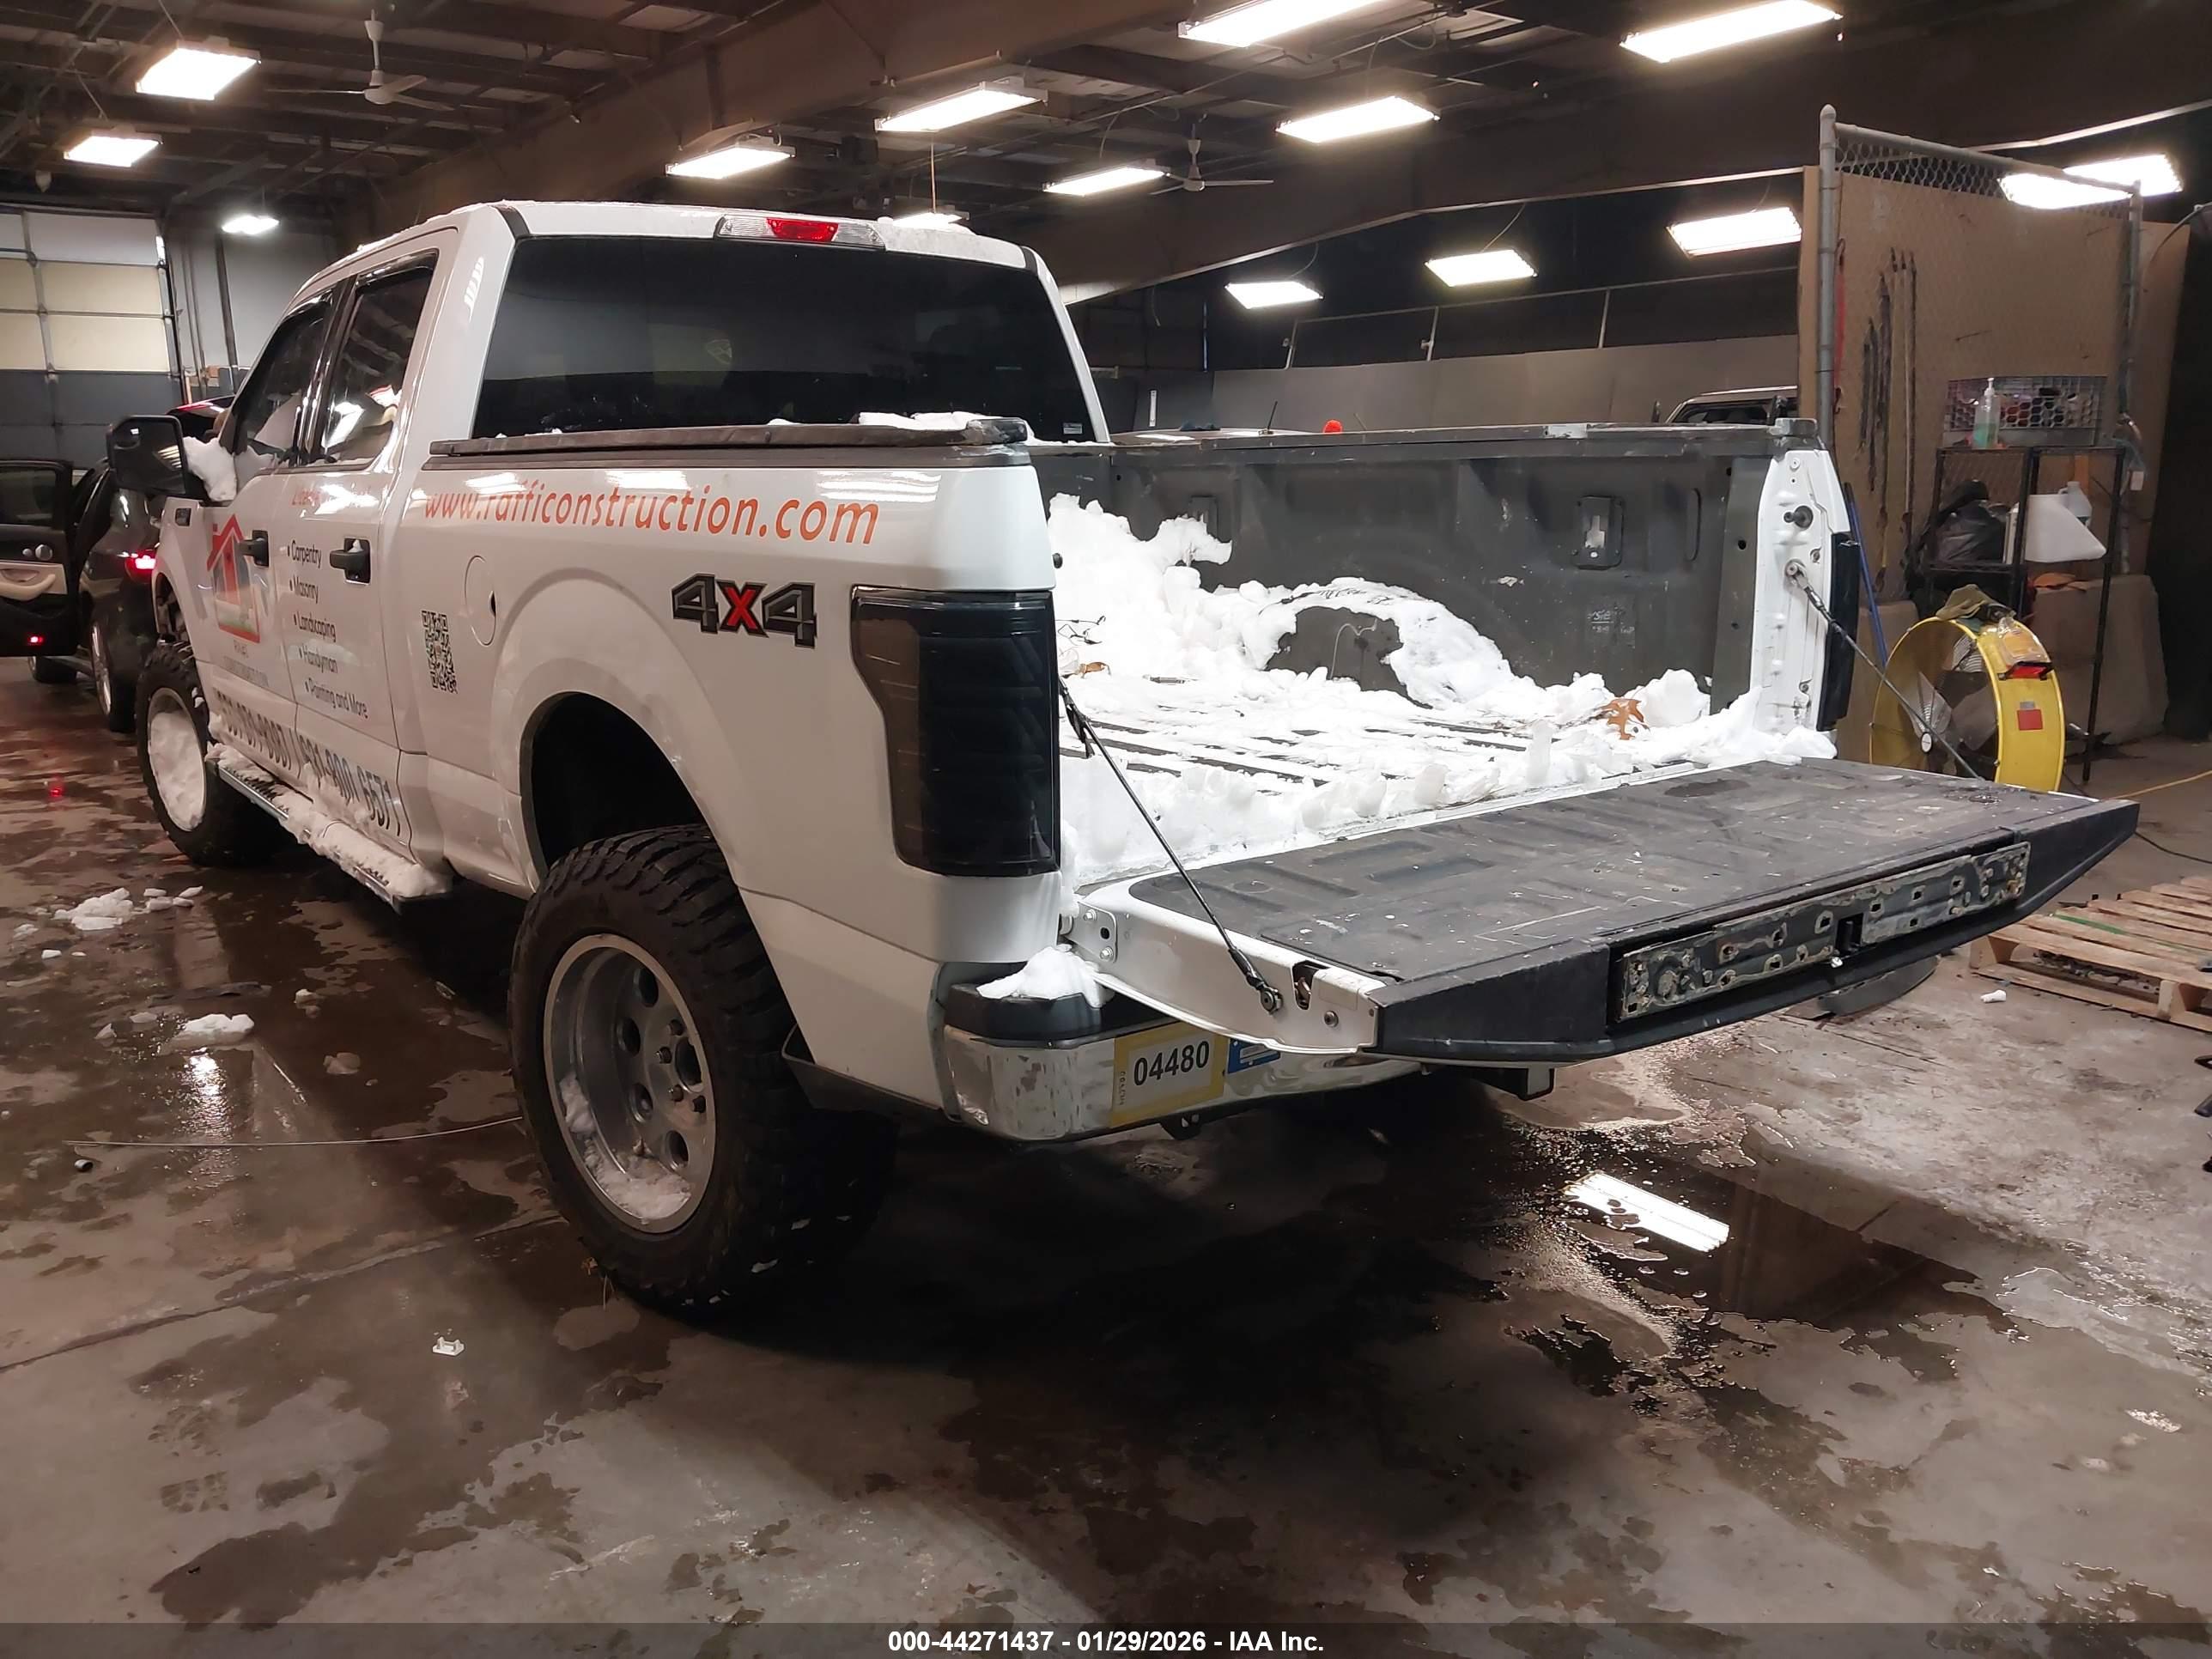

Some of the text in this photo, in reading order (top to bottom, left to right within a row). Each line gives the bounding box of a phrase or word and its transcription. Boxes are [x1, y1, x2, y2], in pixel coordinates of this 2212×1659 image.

[424, 477, 880, 545] www.rafficonstruction.com
[291, 539, 322, 569] Carpentry
[293, 574, 319, 605] Masonry
[296, 611, 337, 643] Landscaping
[301, 642, 338, 674] Handyman
[1133, 1040, 1210, 1086] 04480
